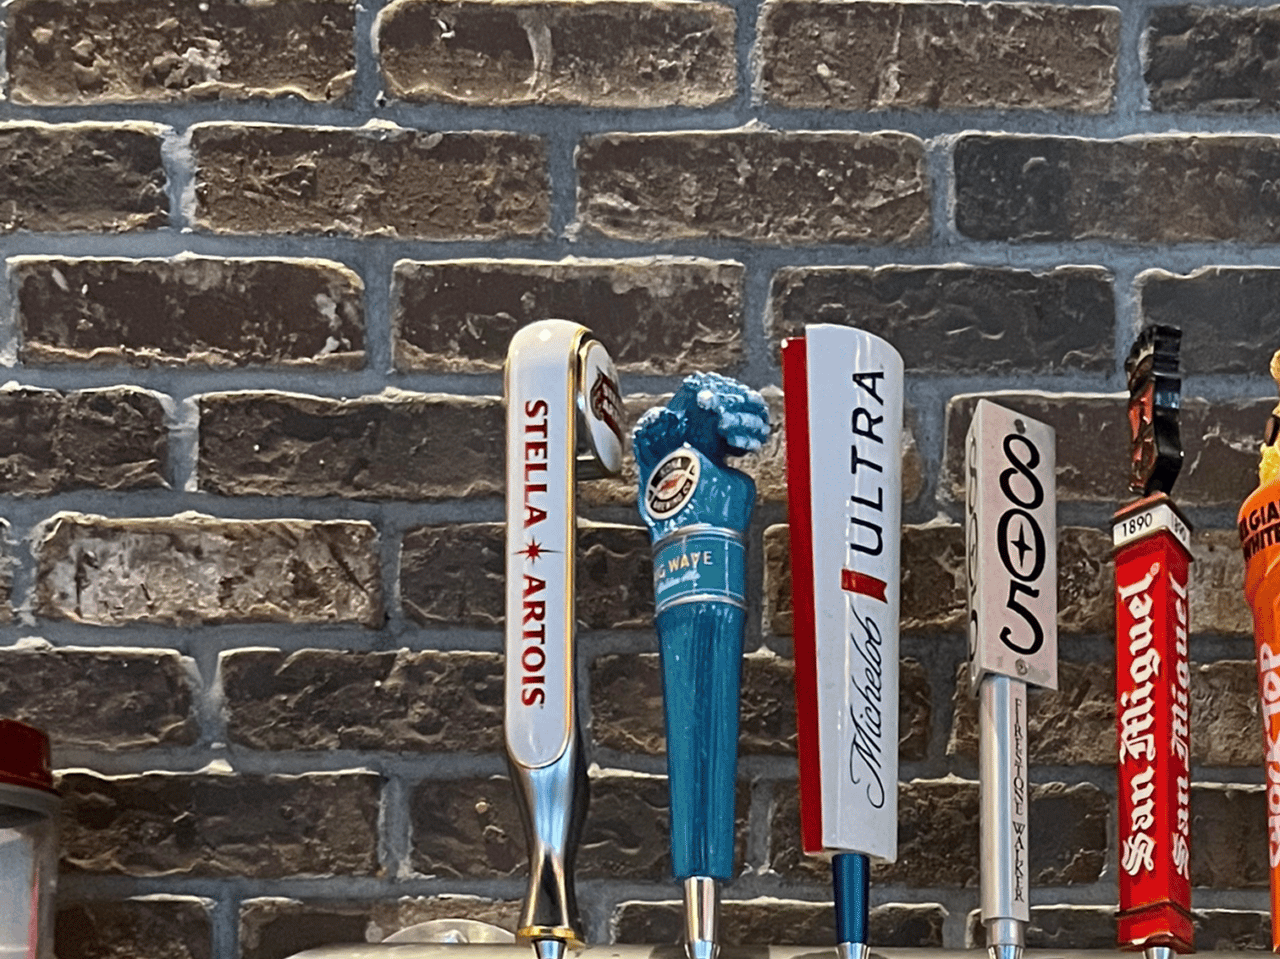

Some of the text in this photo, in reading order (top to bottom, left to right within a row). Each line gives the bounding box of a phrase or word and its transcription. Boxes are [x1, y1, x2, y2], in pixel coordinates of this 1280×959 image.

[521, 399, 549, 708] STELLA ARTOIS
[668, 551, 713, 573] WAVE
[849, 369, 886, 810] Michelob ULTRA
[1122, 512, 1153, 537] 1890
[1012, 698, 1026, 903] FIRESTONE WALKER
[1119, 563, 1161, 876] San Miguel
[1170, 571, 1191, 880] San Miguel
